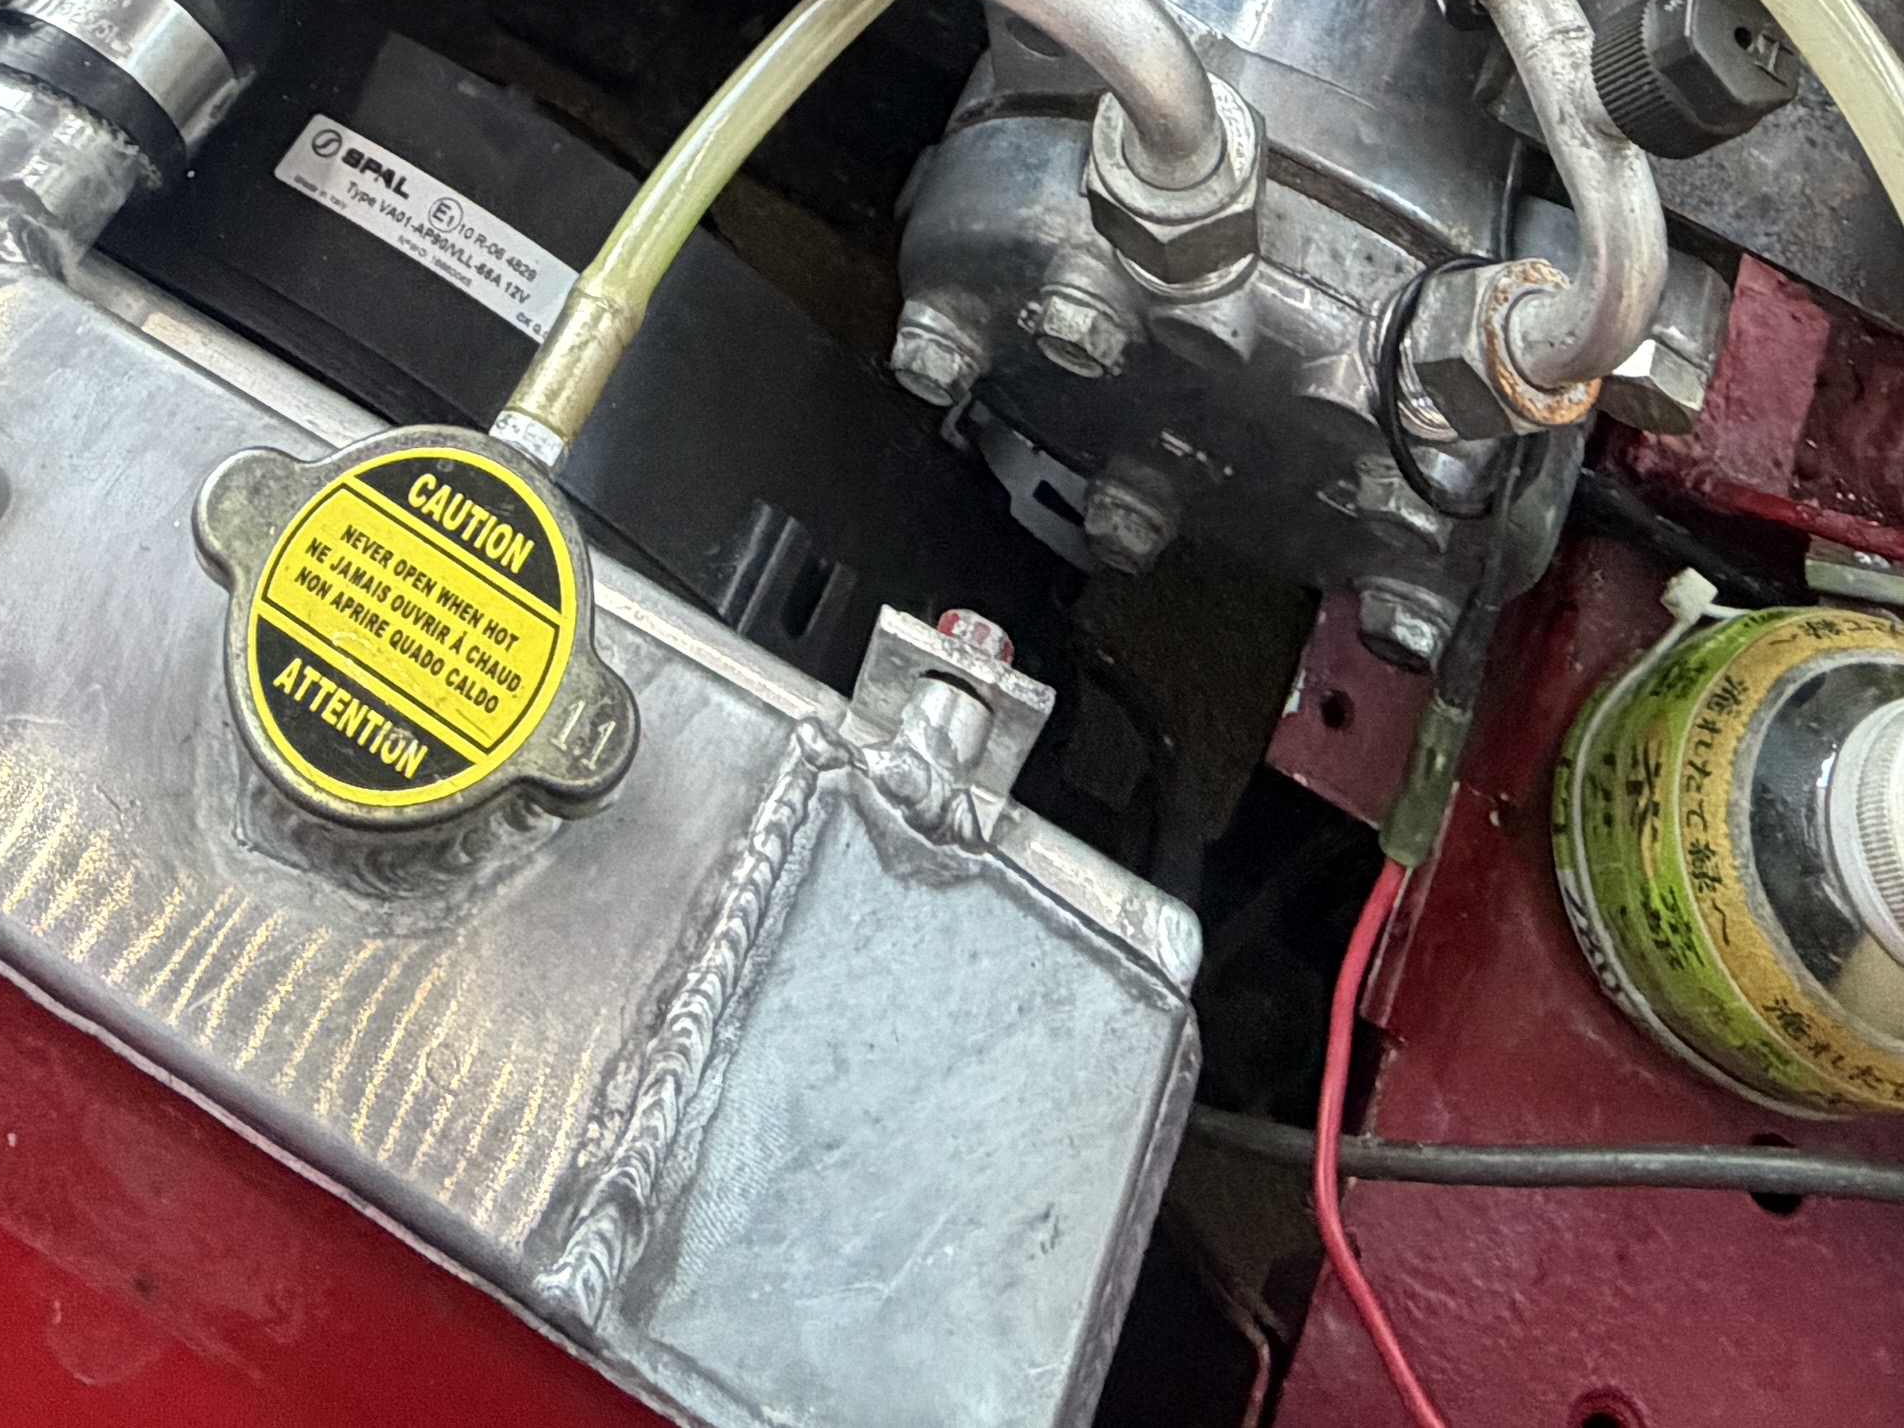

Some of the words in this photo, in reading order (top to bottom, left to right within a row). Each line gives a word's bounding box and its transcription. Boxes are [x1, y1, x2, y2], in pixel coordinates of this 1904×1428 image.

[341, 147, 411, 201] SPAL
[344, 180, 378, 208] Type
[502, 280, 532, 305] 12V
[407, 473, 535, 574] CAUTION
[294, 568, 330, 599] NON
[330, 593, 386, 638] APRIRE
[389, 629, 445, 677] QUADO
[445, 668, 499, 715] CALDO
[305, 537, 330, 563] NE
[330, 551, 391, 605] JAMAIS
[390, 595, 452, 647] OUVRIR
[449, 634, 464, 655] À
[466, 646, 522, 693] CHAUD
[340, 524, 393, 569] NEVER
[393, 560, 437, 599] OPEN
[436, 586, 483, 628] WHEN
[482, 618, 520, 653] HOT
[273, 658, 428, 779] ATTENTION
